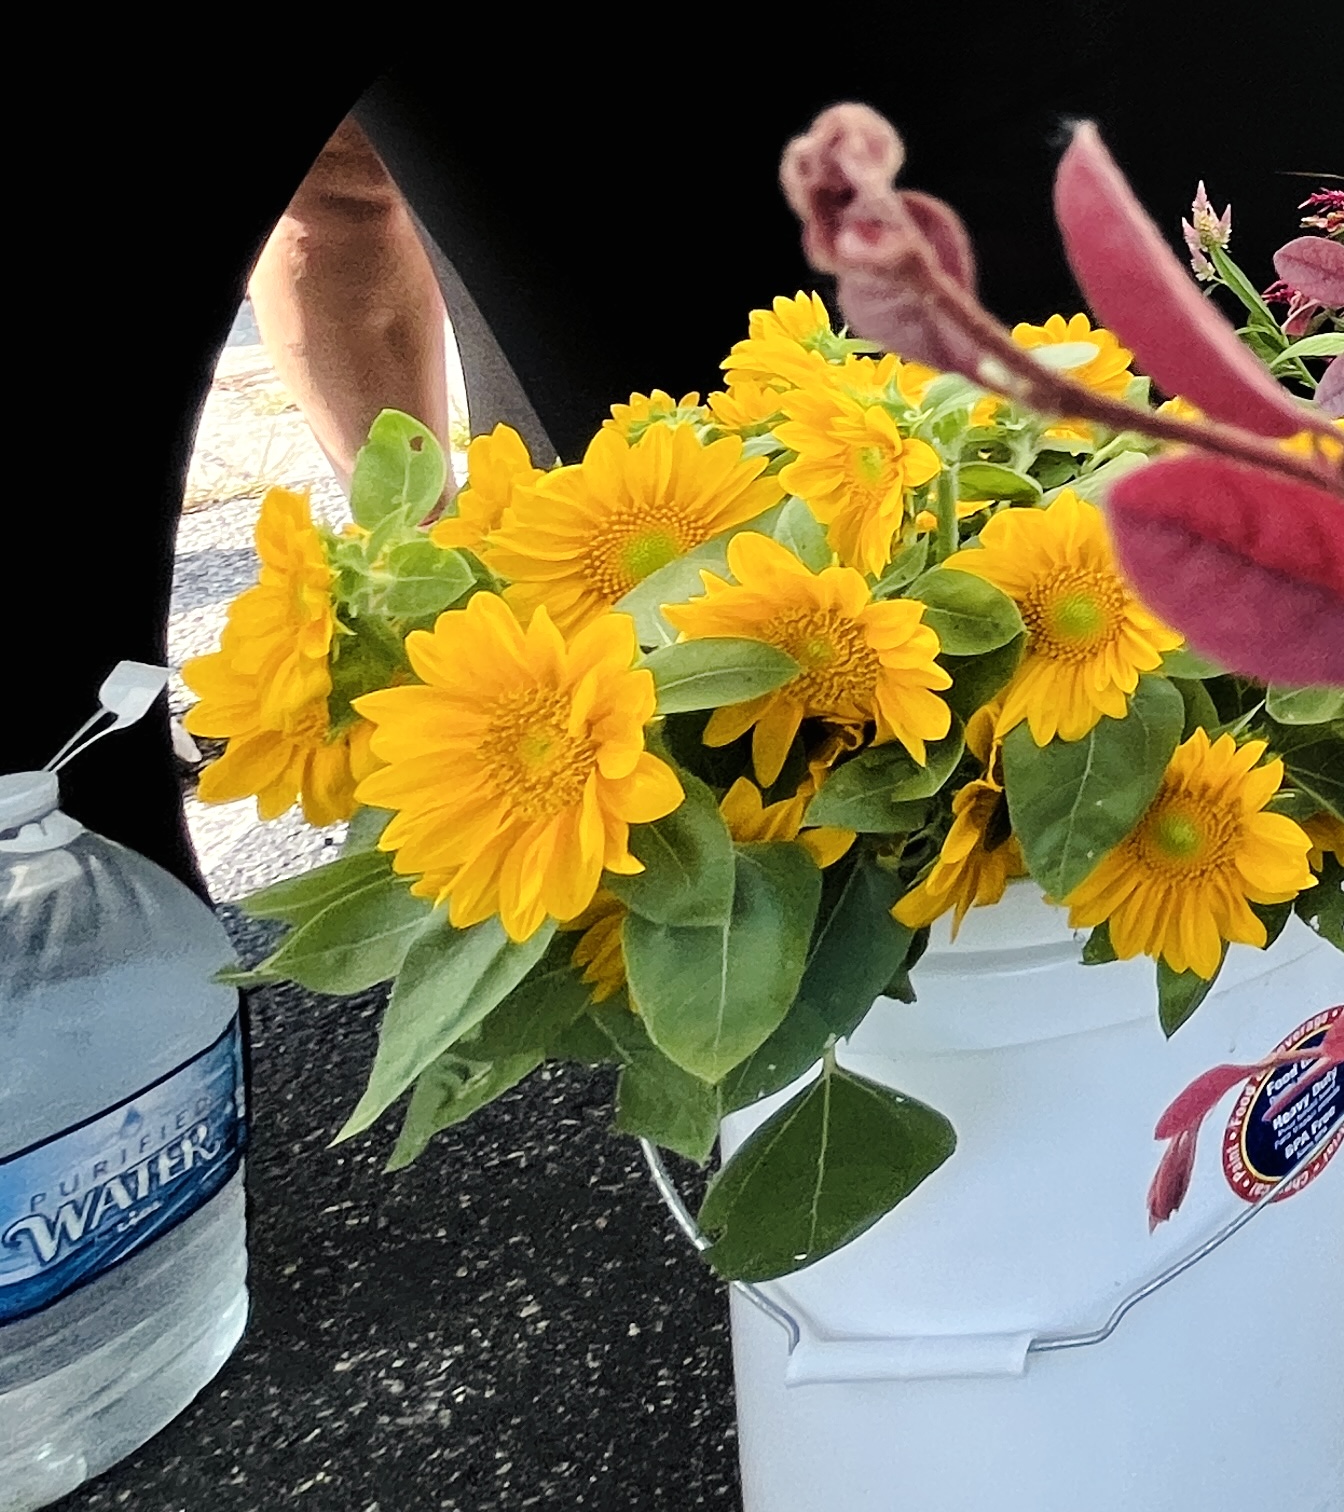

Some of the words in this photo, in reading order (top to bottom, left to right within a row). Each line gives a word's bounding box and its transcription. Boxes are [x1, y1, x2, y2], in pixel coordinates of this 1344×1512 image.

[1229, 1084, 1257, 1128] Food
[1266, 1063, 1299, 1097] Food
[1273, 1093, 1310, 1130] Heavy
[1312, 1066, 1338, 1097] Duty
[30, 1096, 211, 1213] PURIFIED
[1285, 1130, 1310, 1160] BPA
[1311, 1105, 1336, 1135] Free
[1226, 1142, 1247, 1183] Paint
[4, 1124, 221, 1265] WATER
